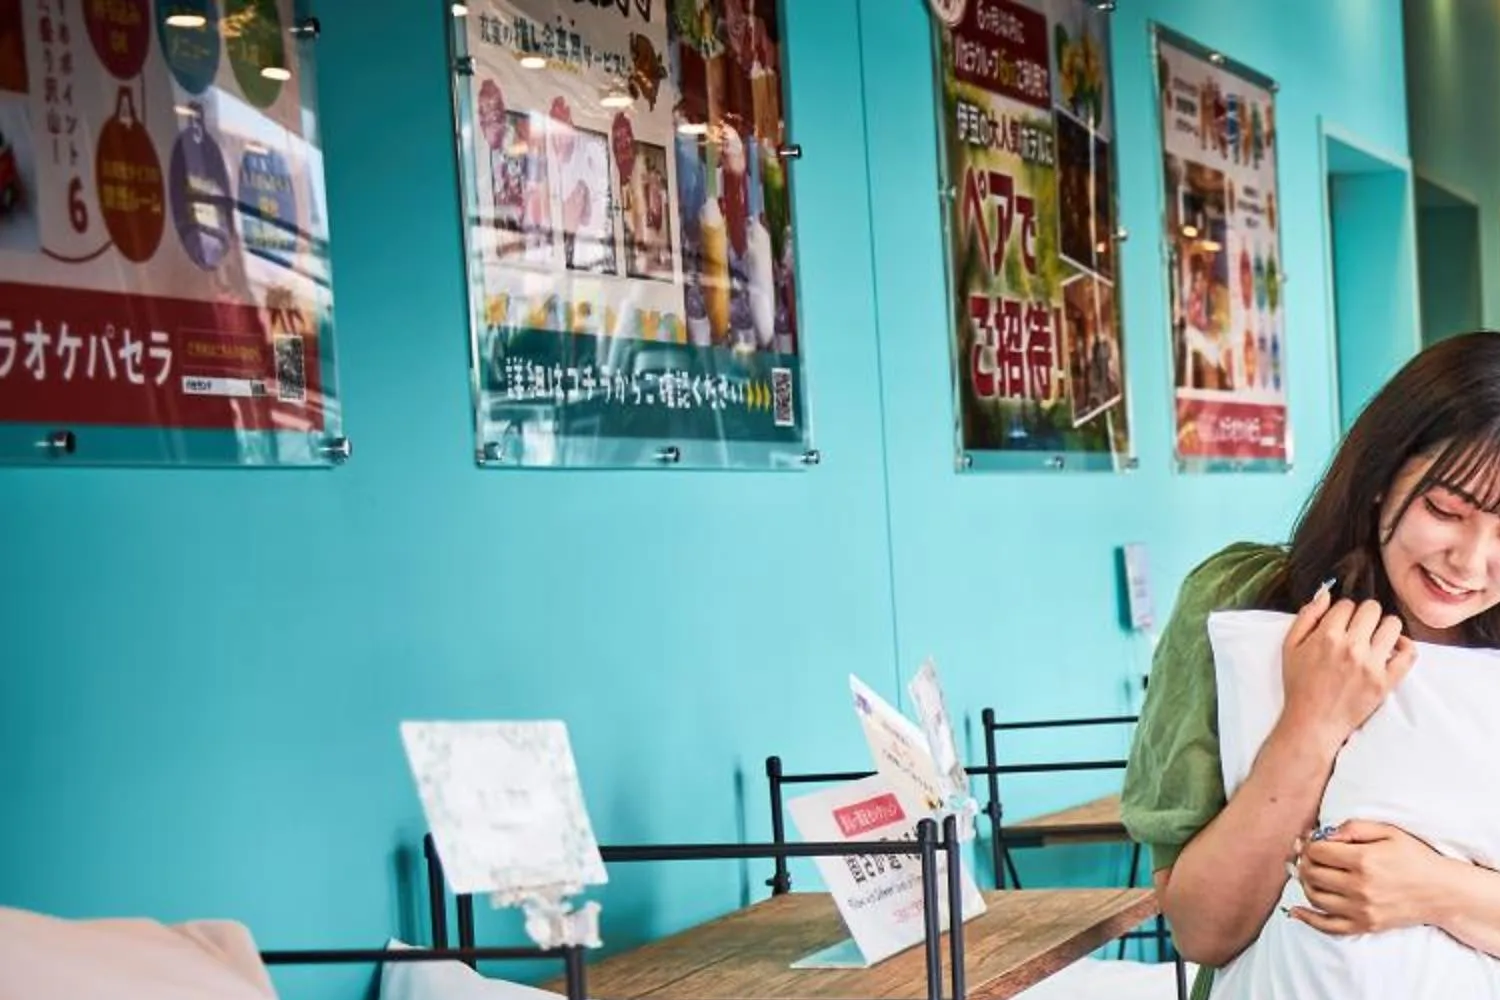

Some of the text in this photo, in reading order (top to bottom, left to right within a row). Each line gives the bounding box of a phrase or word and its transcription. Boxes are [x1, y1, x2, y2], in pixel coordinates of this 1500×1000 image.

[962, 165, 1037, 275] ペアで
[0, 319, 173, 386] ラオケパセラ
